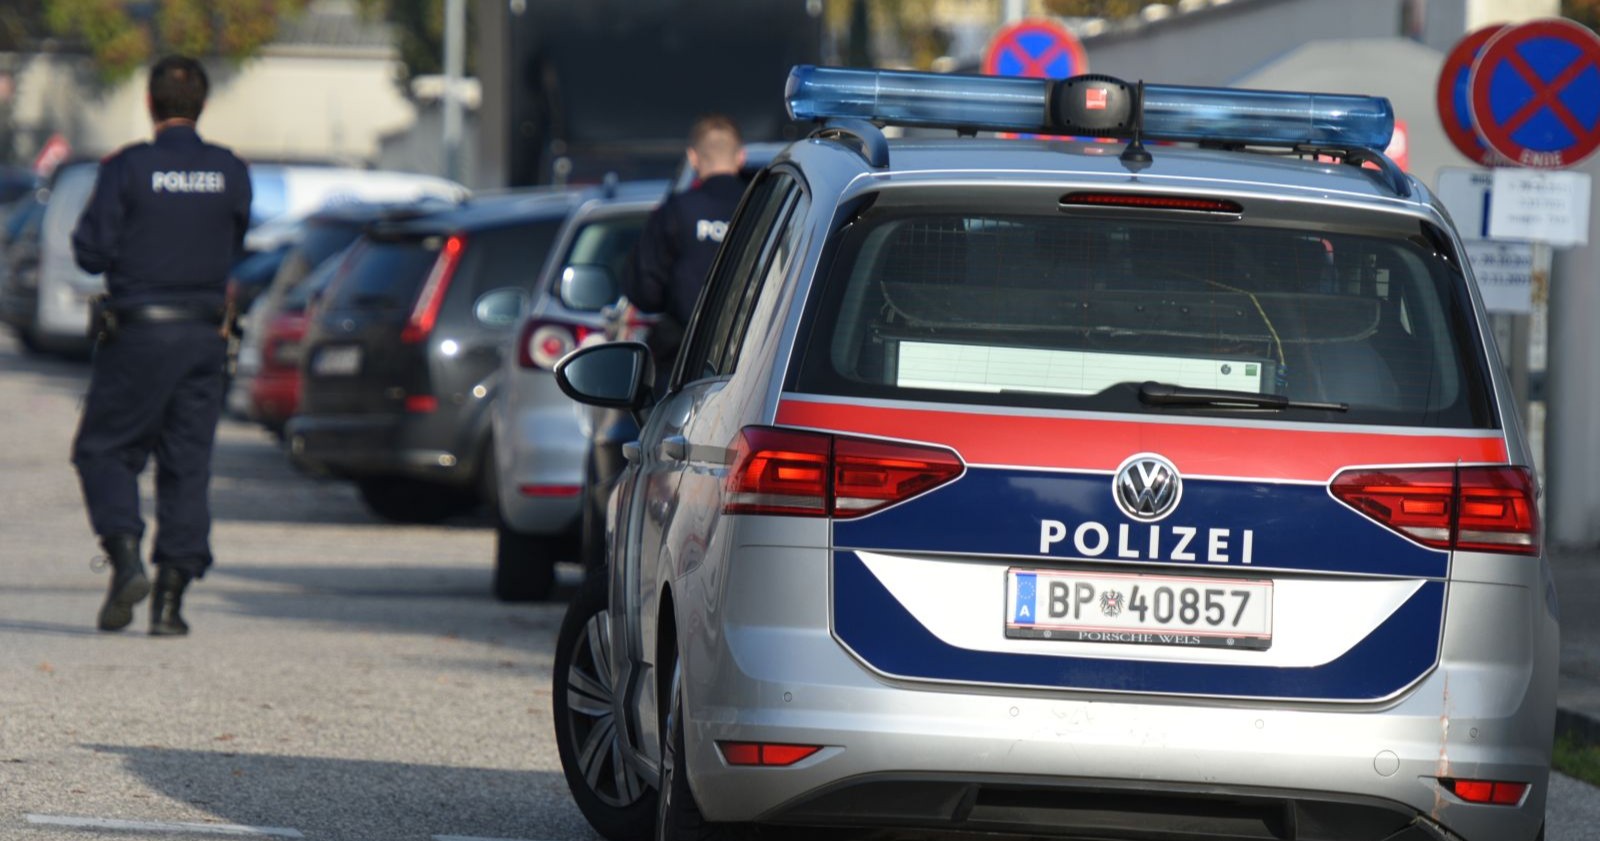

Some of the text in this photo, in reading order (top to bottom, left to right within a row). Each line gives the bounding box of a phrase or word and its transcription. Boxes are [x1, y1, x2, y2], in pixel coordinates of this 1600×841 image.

[152, 171, 225, 192] POLIZEI
[697, 219, 731, 242] PO
[1040, 520, 1253, 564] POLIZEI
[1019, 605, 1030, 618] A
[1049, 581, 1251, 627] BP 40857
[1078, 631, 1200, 645] PORSCHE WELS
